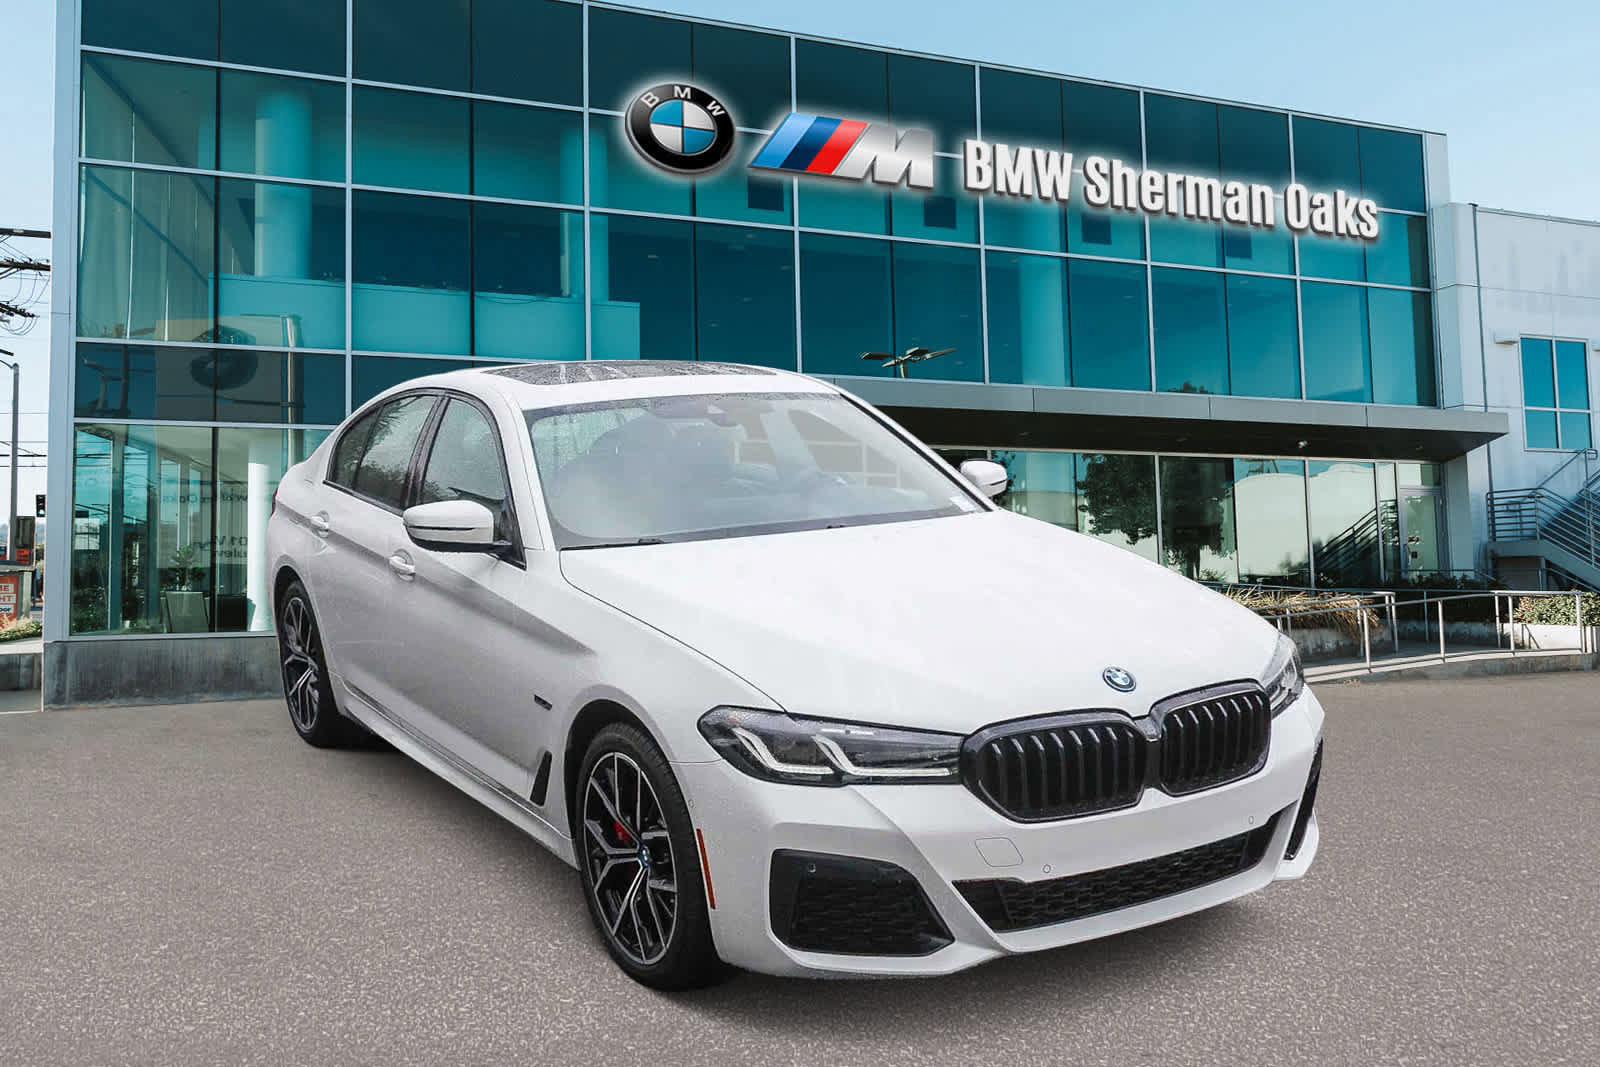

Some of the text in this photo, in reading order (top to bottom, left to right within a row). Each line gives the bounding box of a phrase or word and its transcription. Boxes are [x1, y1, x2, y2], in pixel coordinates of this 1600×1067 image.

[641, 85, 726, 117] BMW
[963, 138, 1380, 242] BMW Sherman Oaks
